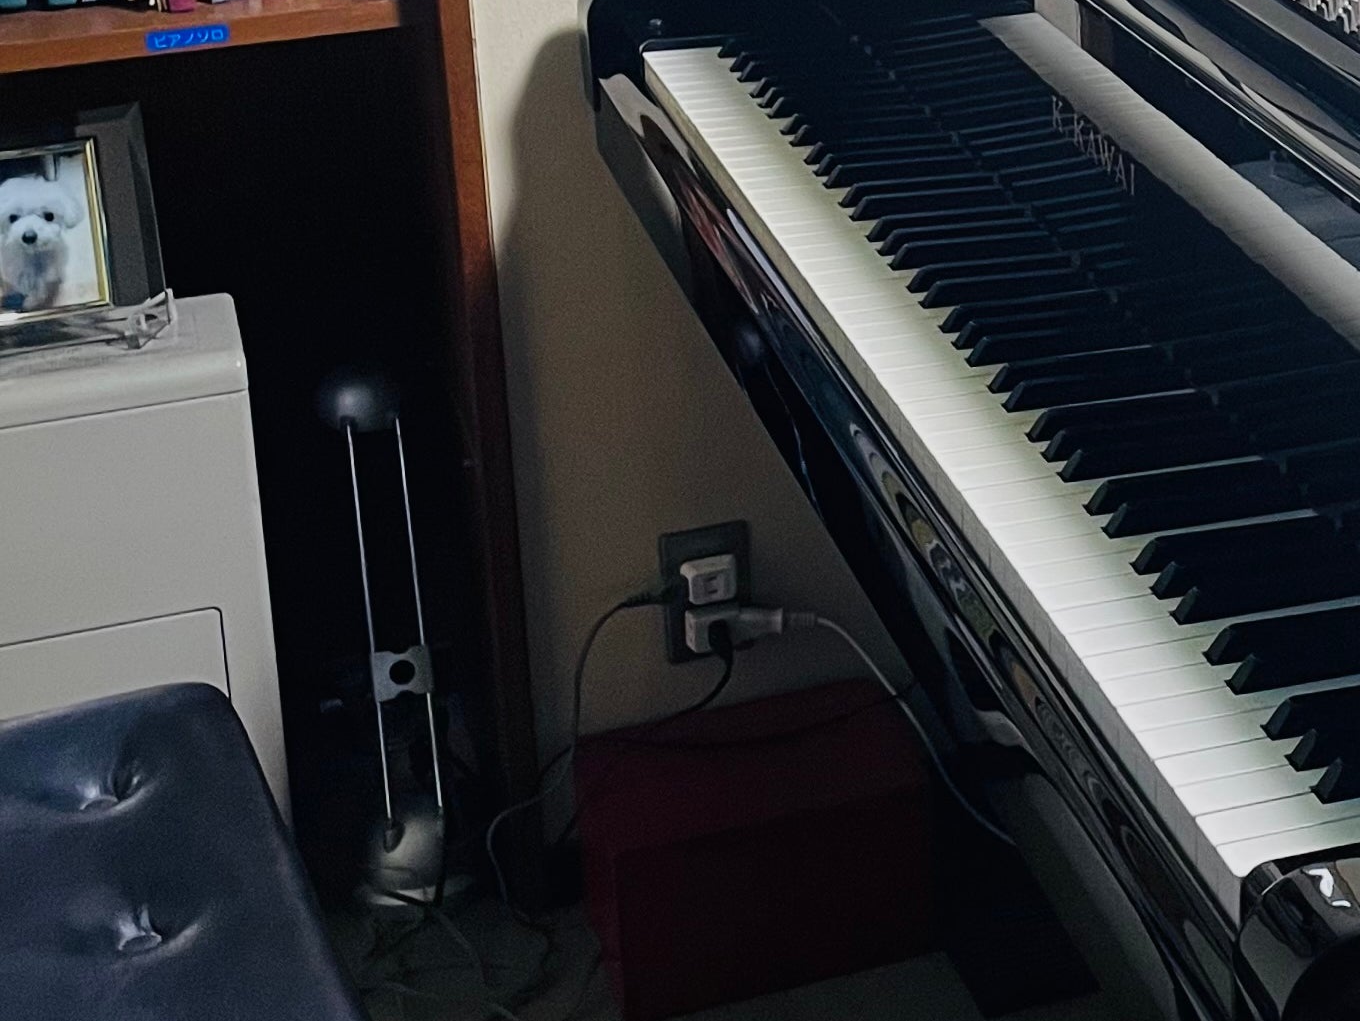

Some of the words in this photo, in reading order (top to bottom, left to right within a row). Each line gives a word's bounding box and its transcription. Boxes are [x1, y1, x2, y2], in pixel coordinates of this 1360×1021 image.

[153, 27, 225, 49] ピアノソロ
